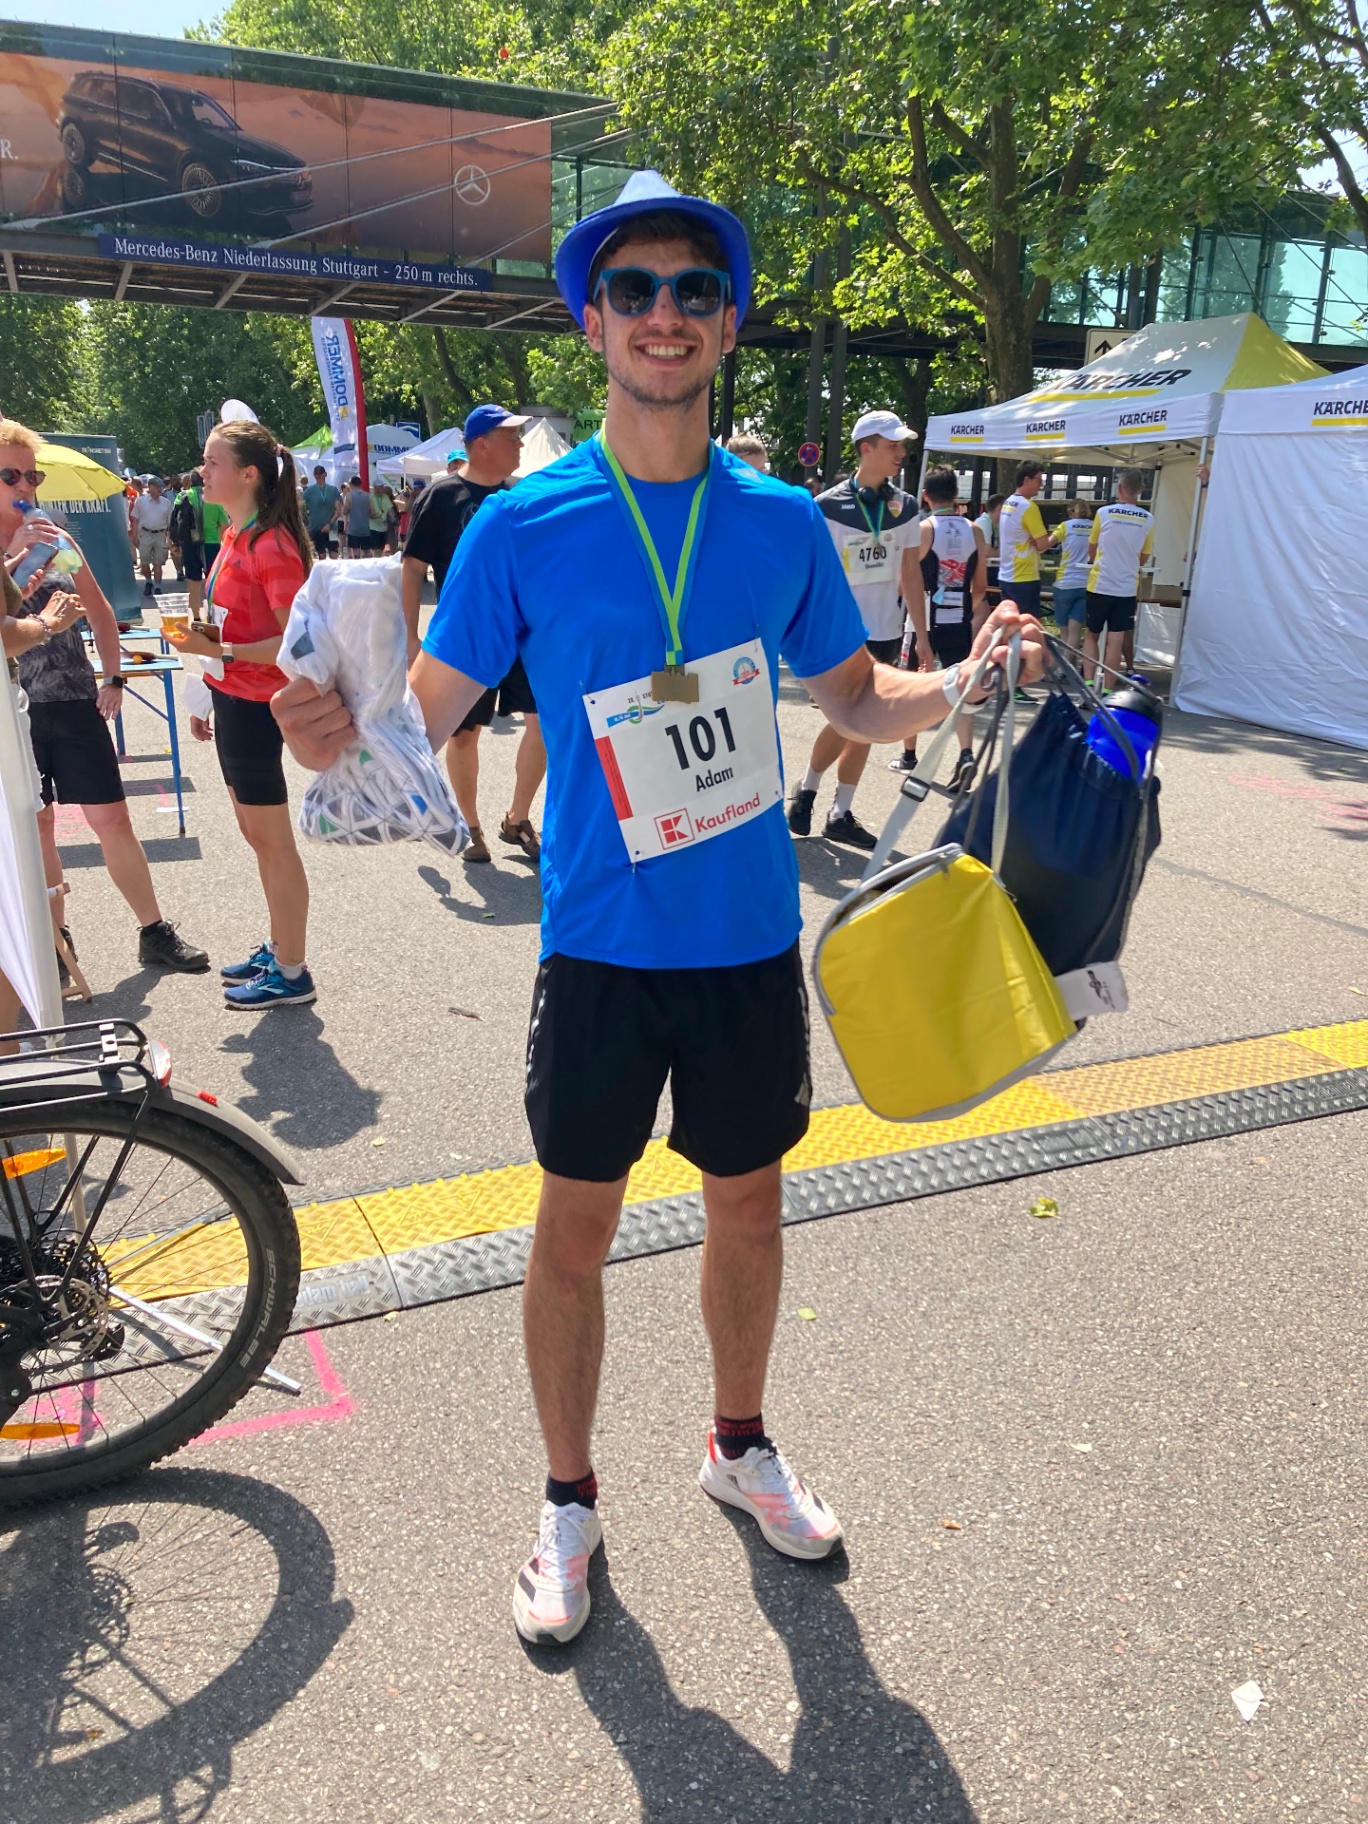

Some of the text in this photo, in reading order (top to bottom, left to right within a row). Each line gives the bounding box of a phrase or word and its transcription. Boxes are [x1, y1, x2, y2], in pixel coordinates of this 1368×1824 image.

[114, 237, 218, 263] Mercedes-Benz
[223, 247, 317, 276] Niederlassung
[322, 257, 379, 279] Stuttgart
[395, 264, 418, 281] 250
[438, 268, 478, 286] rechts.
[950, 424, 984, 435] KÄRCHER
[1026, 419, 1066, 433] KÄRCHER
[1119, 409, 1168, 427] KÄRCHER
[1108, 507, 1148, 519] KÄRCHER
[664, 706, 736, 771] 101
[695, 766, 734, 792] Adam
[695, 792, 761, 833] Kaufland
[240, 1247, 277, 1369] SCHWALBE
